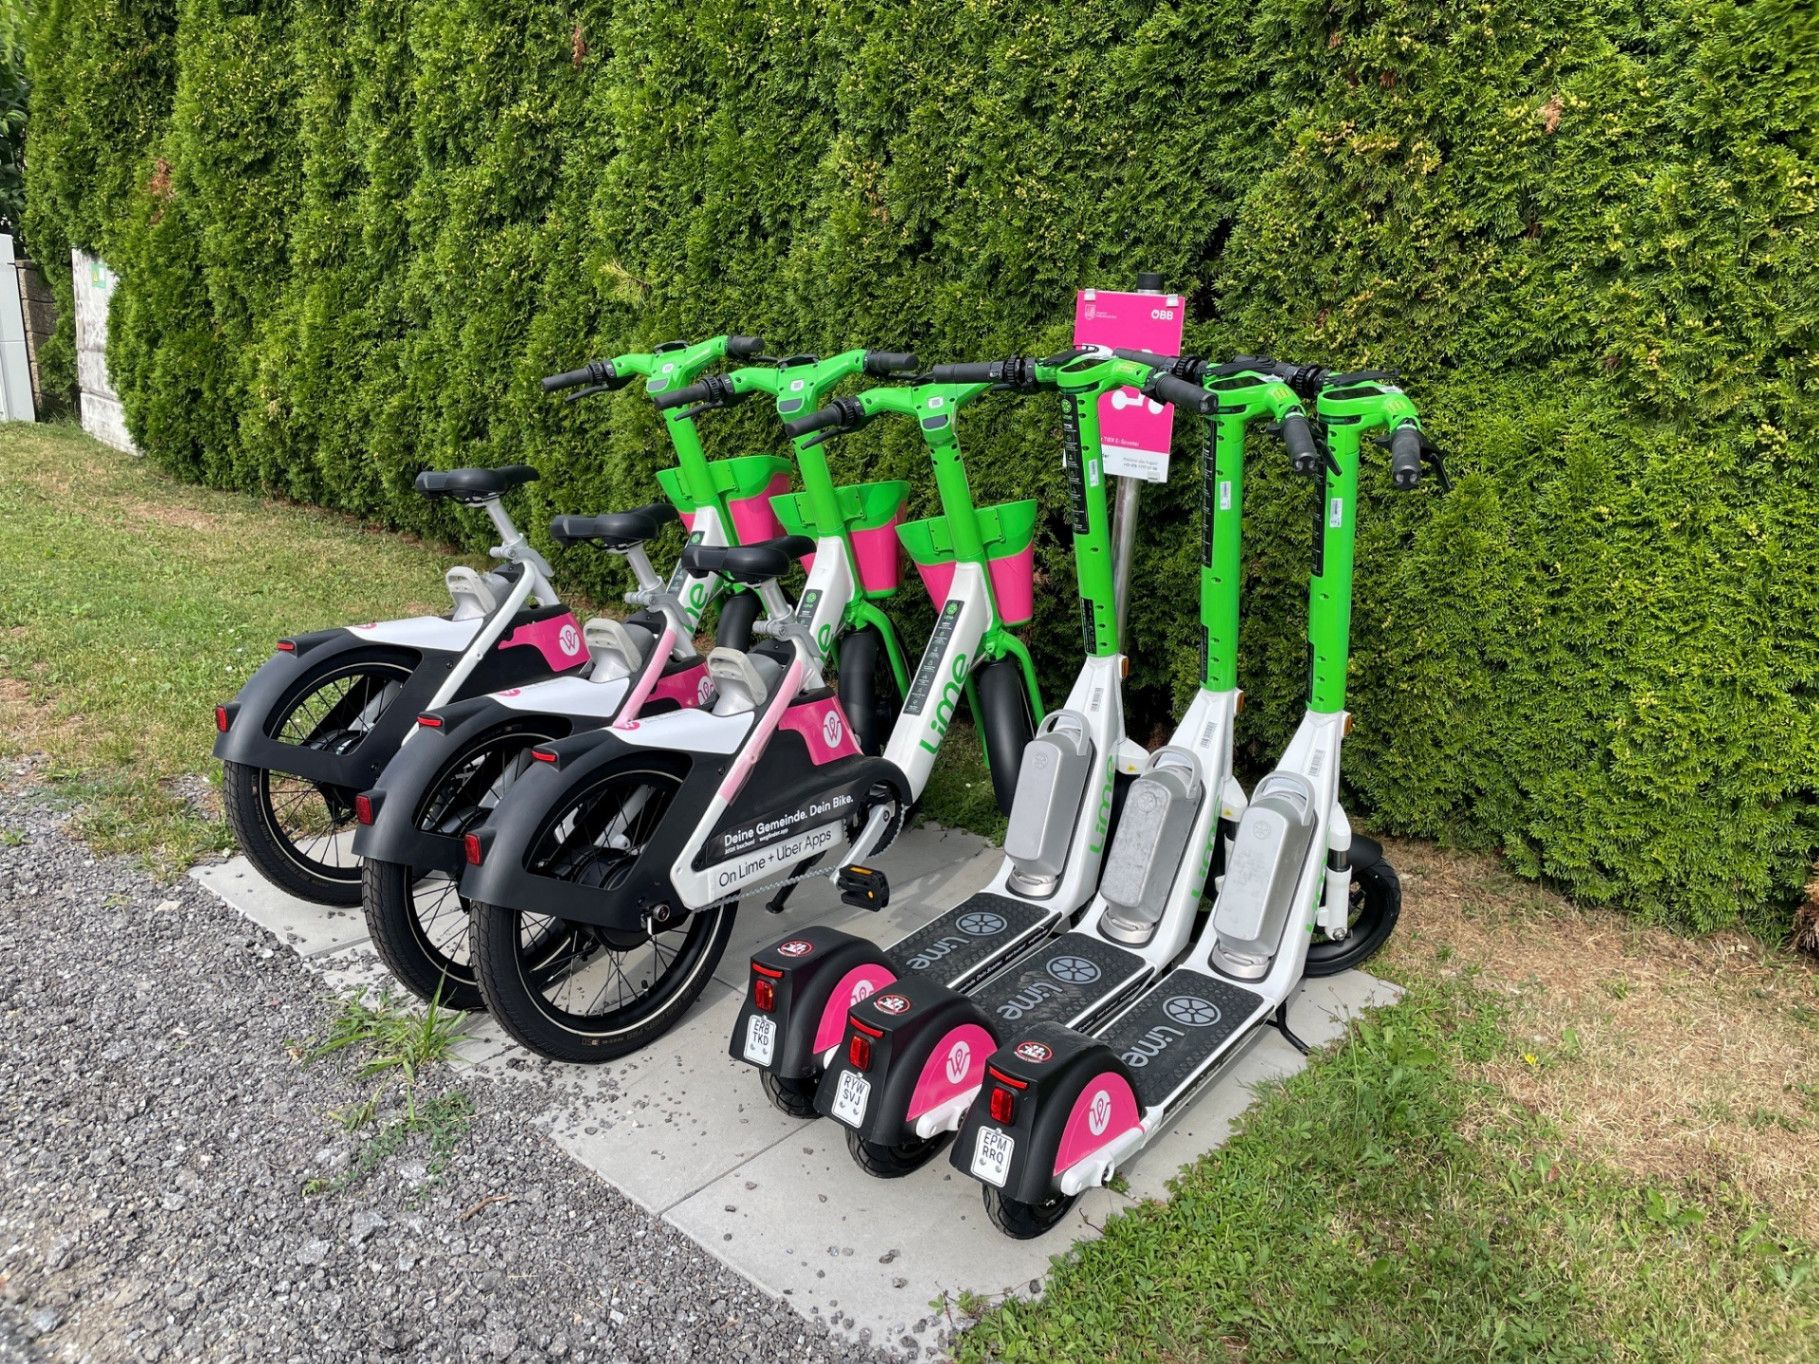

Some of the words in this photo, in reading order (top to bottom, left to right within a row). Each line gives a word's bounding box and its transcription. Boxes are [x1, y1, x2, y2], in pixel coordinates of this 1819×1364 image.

[919, 653, 970, 755] Lime
[724, 829, 754, 847] Deine
[756, 810, 808, 835] Gemeinde.
[809, 801, 831, 817] Dein
[832, 795, 853, 809] Bike.
[719, 870, 737, 887] On
[739, 858, 766, 879] Lime
[768, 853, 775, 863] +
[776, 844, 802, 861] Uber
[804, 829, 832, 849] Apps
[905, 936, 970, 970] Lime
[996, 981, 1064, 1020] Lime
[752, 1031, 769, 1046] TKD
[754, 1019, 771, 1035] ERB
[1121, 1025, 1185, 1067] Lime
[843, 1089, 861, 1106] SVJ
[844, 1075, 866, 1095] RYW
[983, 1131, 1007, 1152] EPM
